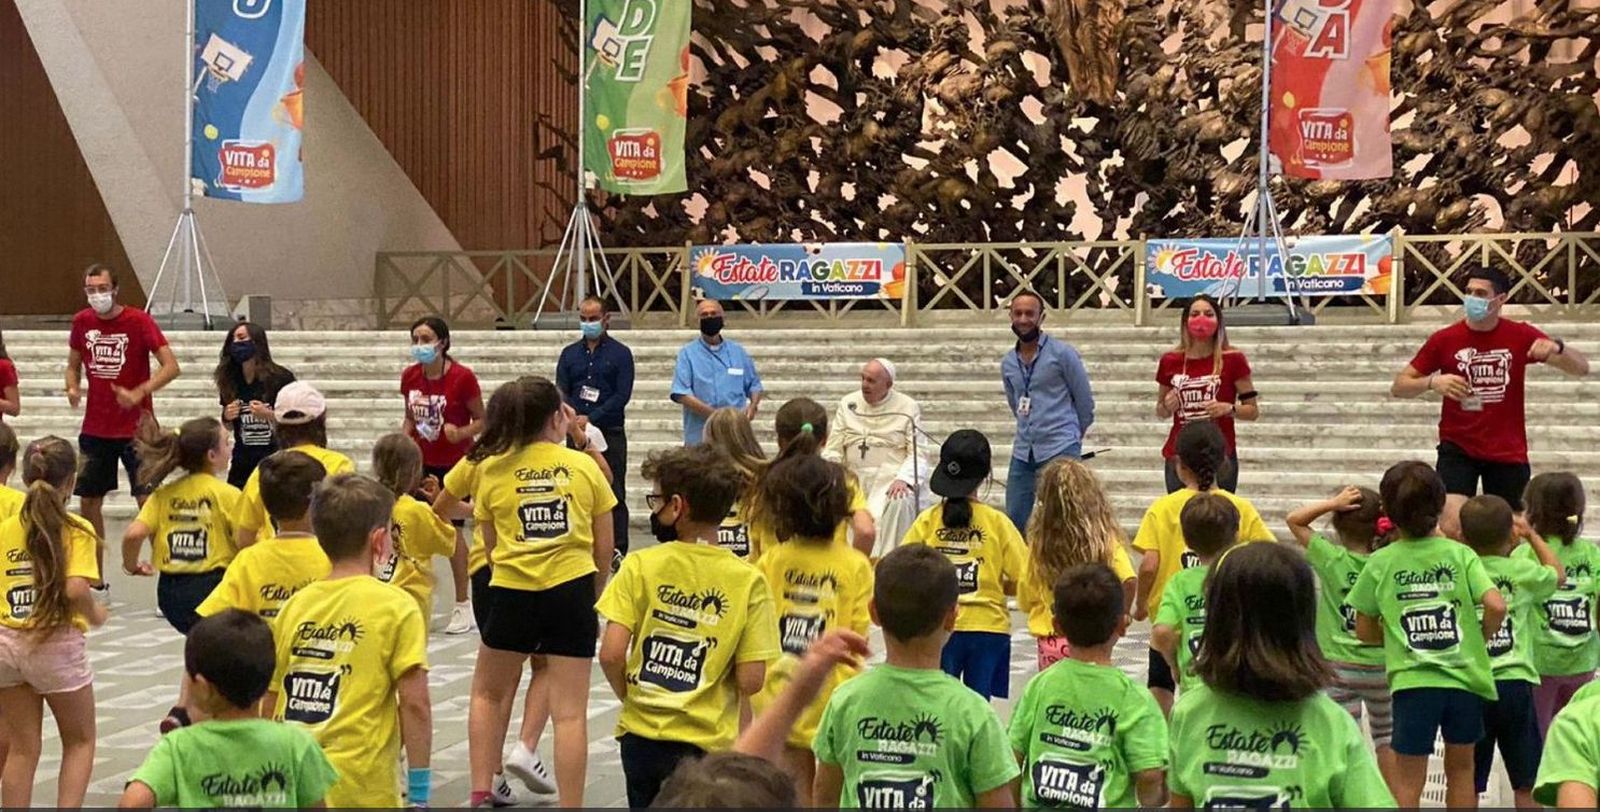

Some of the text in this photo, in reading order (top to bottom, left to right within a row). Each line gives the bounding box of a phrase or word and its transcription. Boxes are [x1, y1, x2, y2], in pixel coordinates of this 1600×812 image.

[1301, 121, 1348, 140] VITA da
[615, 140, 655, 157] VITA da
[1304, 139, 1349, 153] Campione
[225, 150, 270, 168] VITA da
[614, 157, 656, 170] Campione
[226, 166, 271, 178] Campione
[711, 253, 883, 284] Estate RAGAZZI
[811, 282, 863, 293] in Vaticano
[1297, 279, 1344, 289] Vaticano
[96, 346, 112, 356] VITA
[1471, 365, 1494, 376] VITA
[1182, 390, 1203, 401] VITA
[514, 467, 553, 481] Estate
[524, 507, 564, 521] VITA da
[525, 521, 566, 531] Campione
[172, 533, 195, 547] VITA
[717, 530, 735, 543] ITA
[1393, 570, 1436, 586] Estate
[657, 584, 701, 611] Estate
[1548, 604, 1574, 618] VITA
[1406, 615, 1452, 632] VITA da
[1410, 631, 1455, 642] Campione
[1487, 639, 1511, 650] pione
[649, 640, 698, 671] VITA da
[645, 660, 697, 684] Campione
[292, 677, 323, 699] VITA
[288, 697, 331, 714] Campione
[1046, 705, 1096, 732] Estate
[857, 717, 914, 742] Estate
[1206, 724, 1270, 753] Estate
[201, 772, 259, 797] Estate
[1040, 765, 1096, 795] VITA da
[864, 787, 926, 808] VITA da
[1038, 786, 1095, 808] Campione
